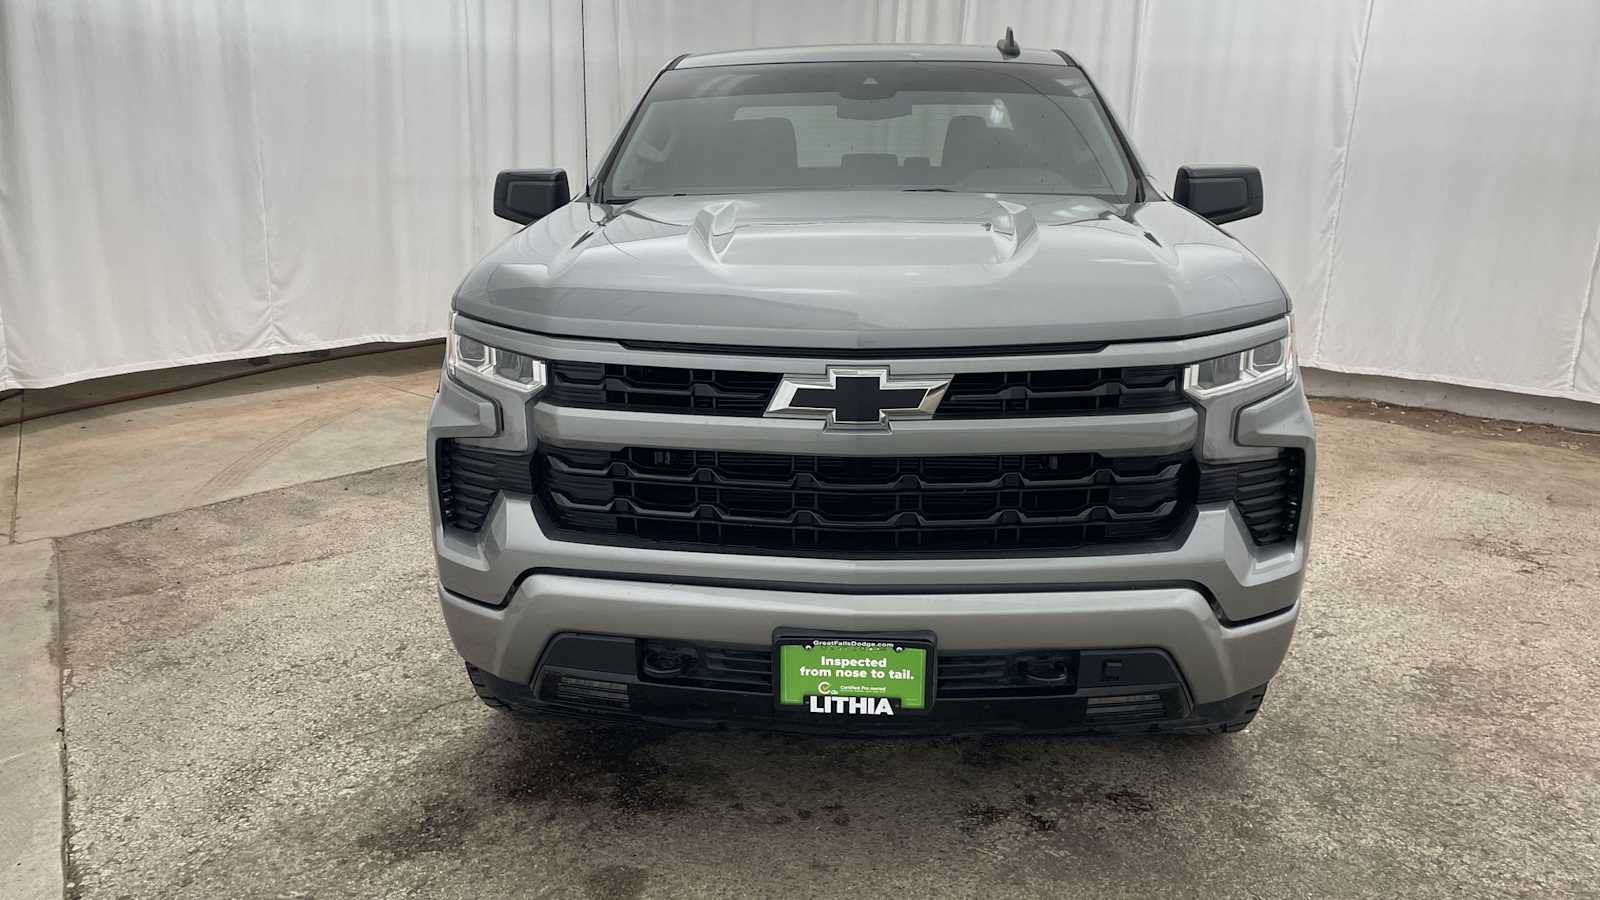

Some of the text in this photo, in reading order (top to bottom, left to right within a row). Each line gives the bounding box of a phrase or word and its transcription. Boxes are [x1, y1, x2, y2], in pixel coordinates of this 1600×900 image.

[813, 640, 894, 648] GreatFallsDodge.com
[821, 656, 887, 668] Inspected
[800, 666, 914, 680] from nose to tail.
[810, 696, 894, 716] LITHIA
